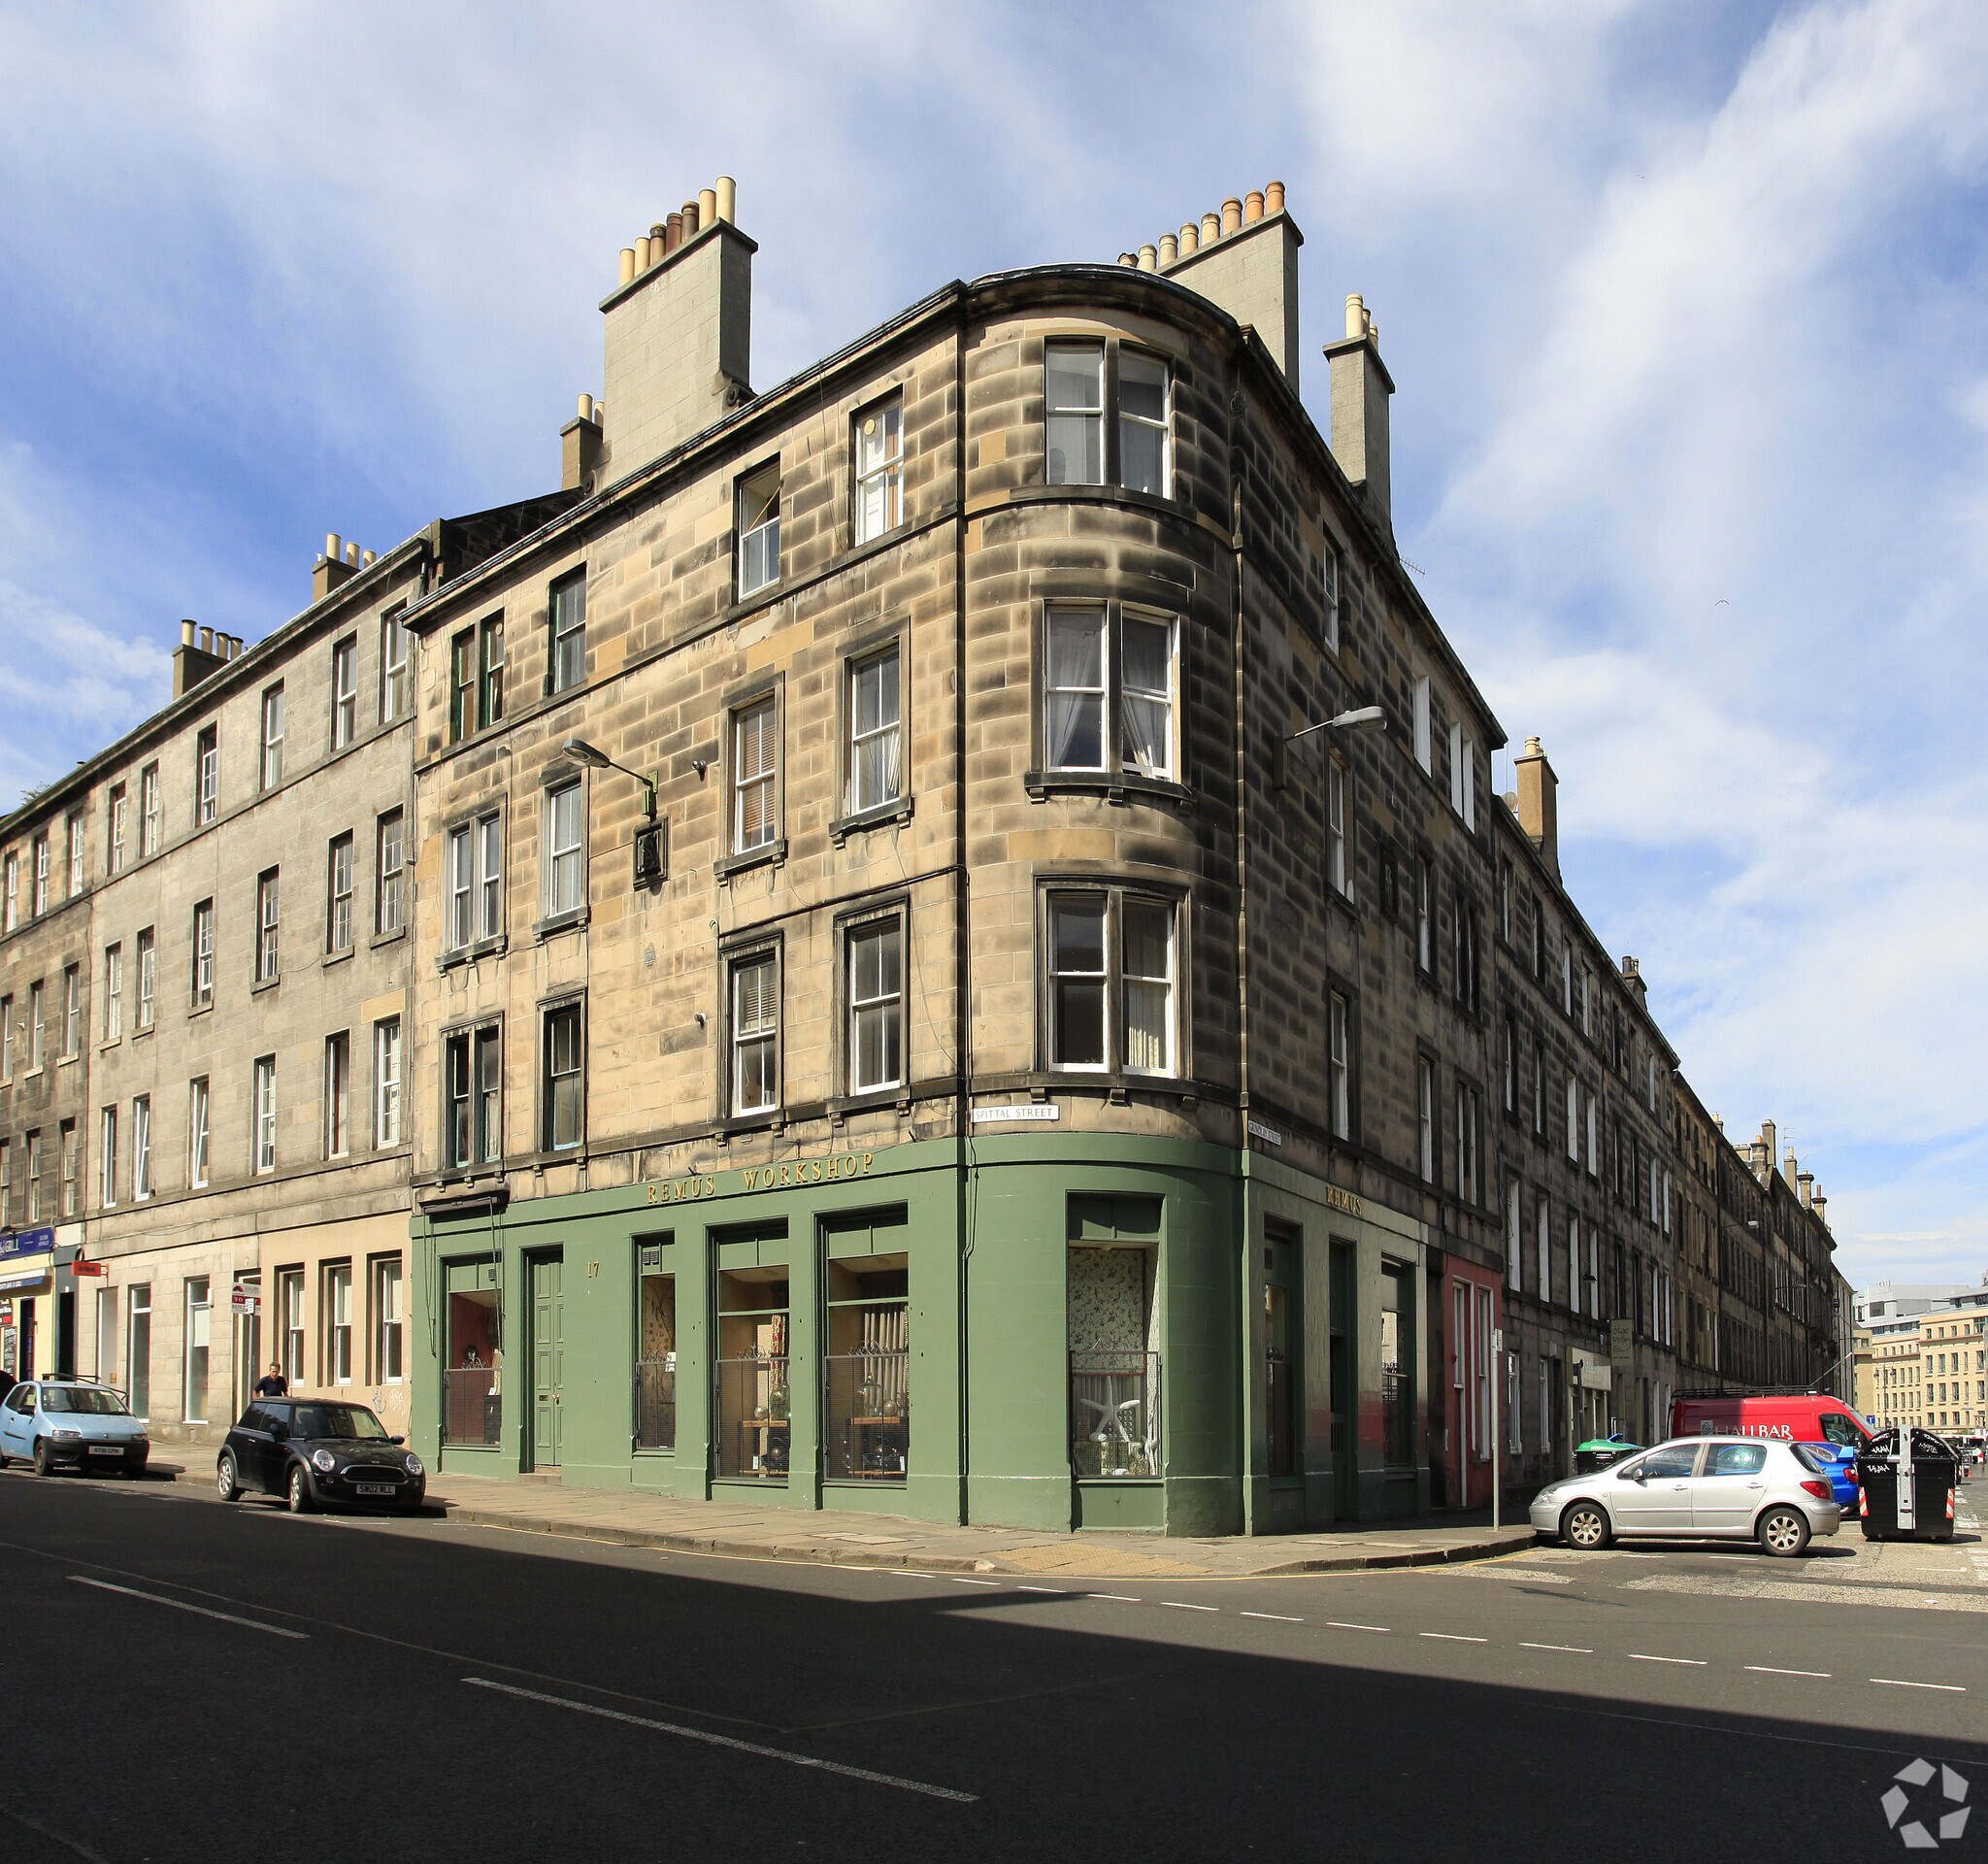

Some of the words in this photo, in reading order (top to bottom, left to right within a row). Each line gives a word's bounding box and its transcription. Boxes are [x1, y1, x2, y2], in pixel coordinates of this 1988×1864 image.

[976, 1110, 1011, 1120] SPITTAL
[1015, 1108, 1053, 1118] STREET
[647, 1176, 715, 1204] REMUS
[743, 1152, 875, 1191] WORKSHOP
[1326, 1184, 1362, 1215] REMUS
[586, 1261, 600, 1279] 17
